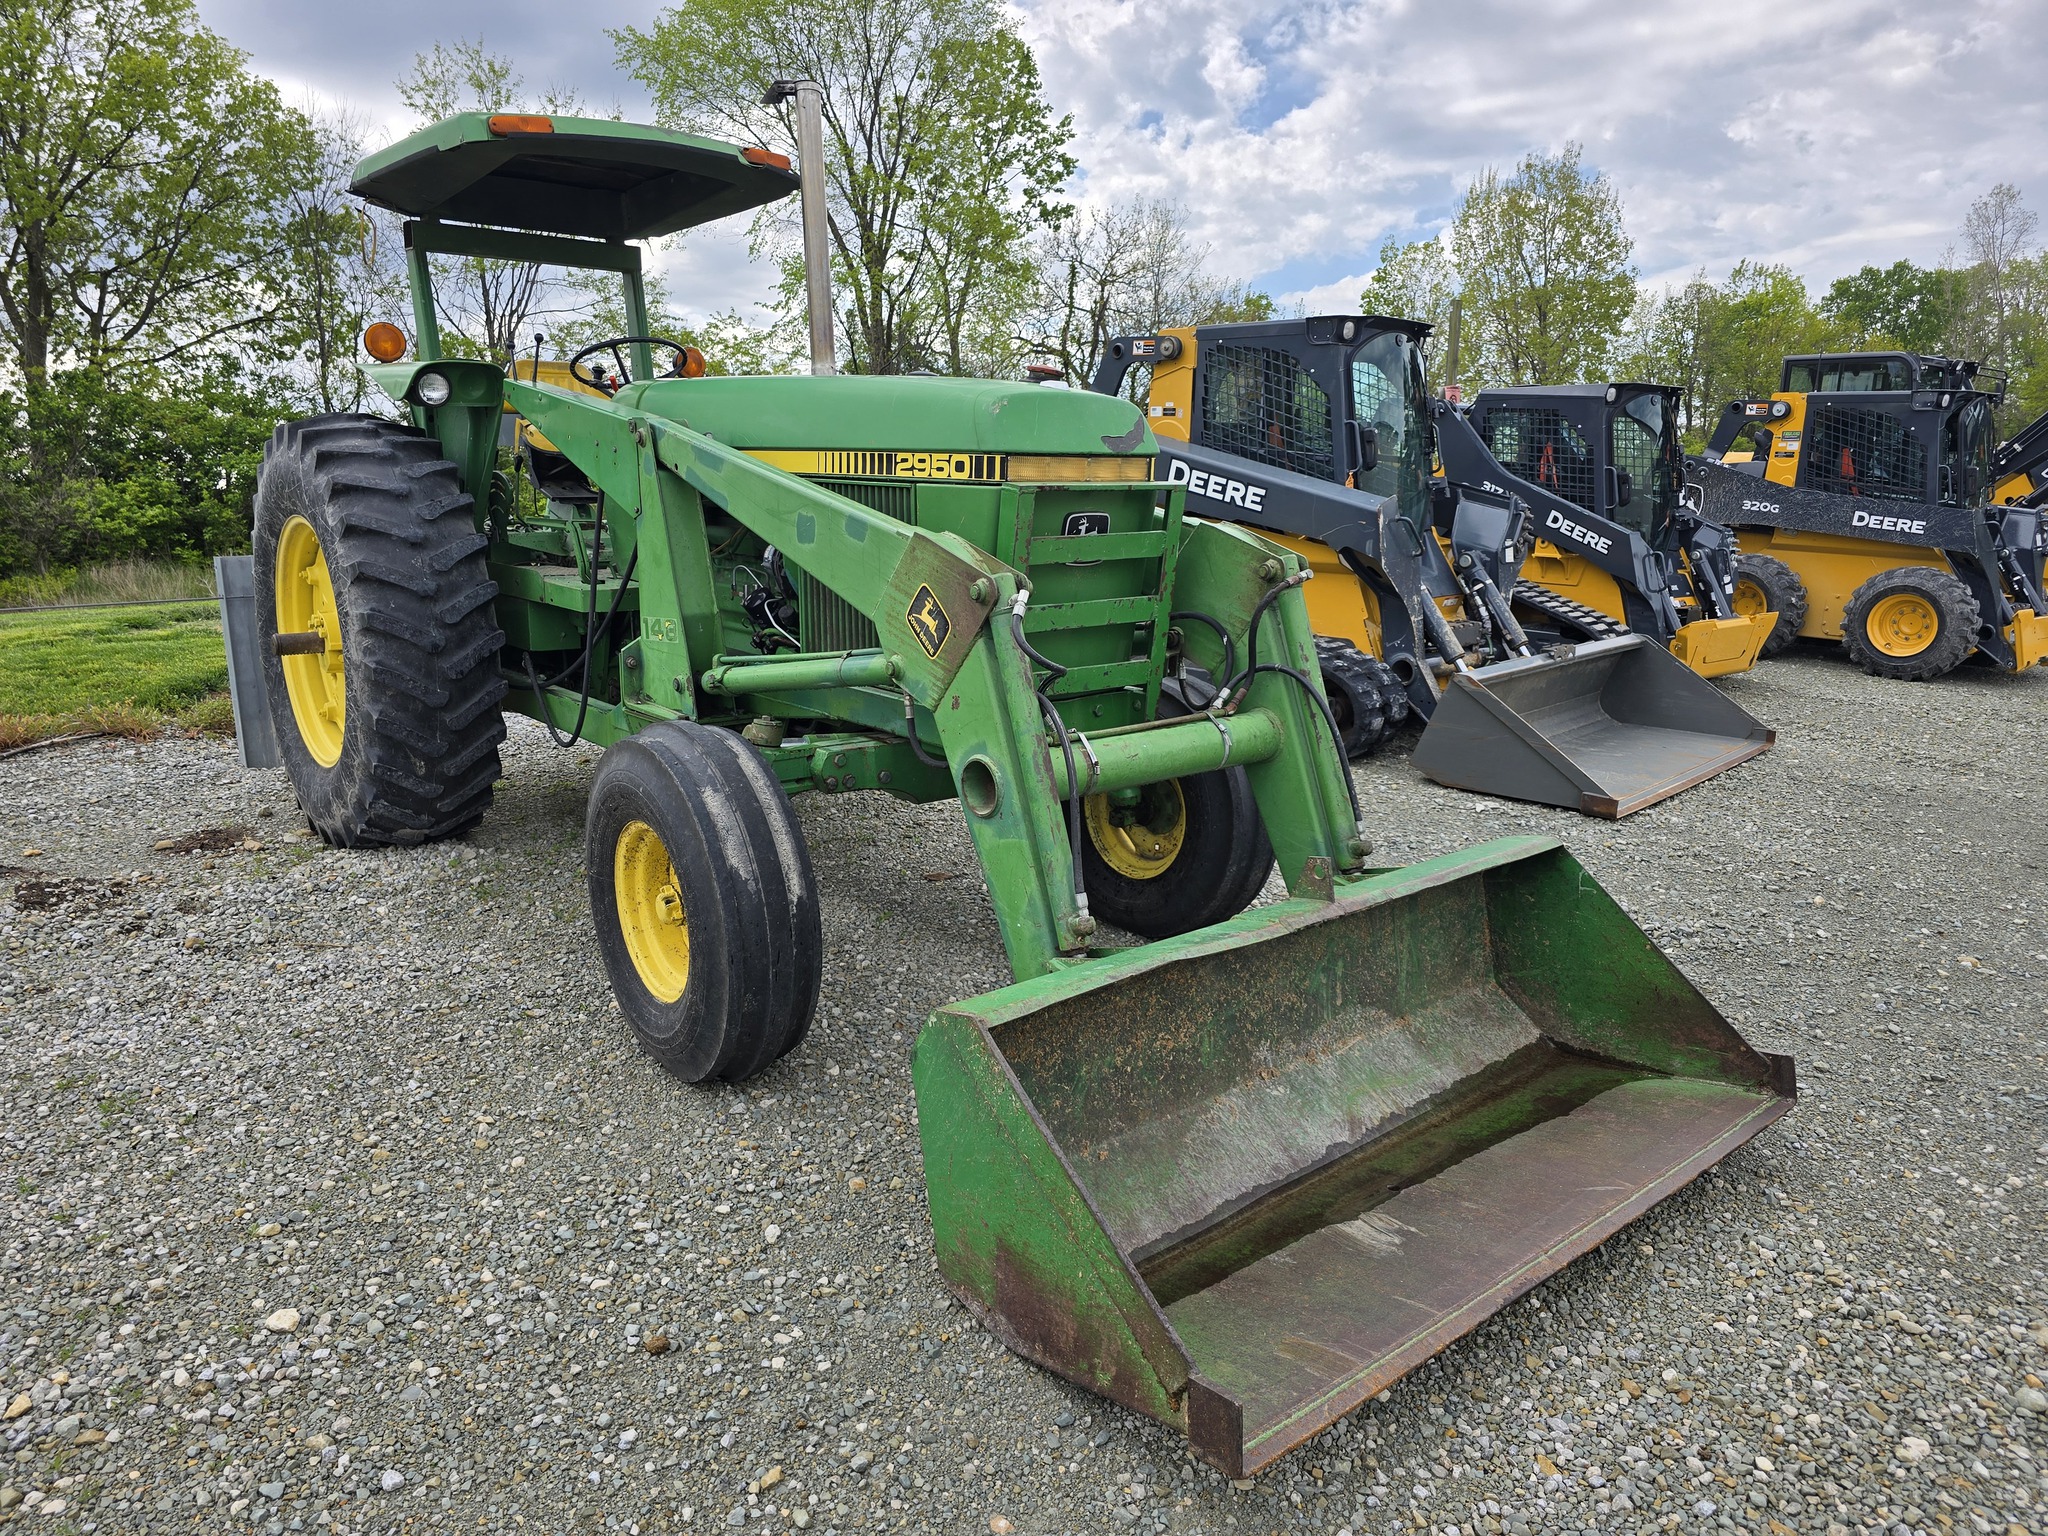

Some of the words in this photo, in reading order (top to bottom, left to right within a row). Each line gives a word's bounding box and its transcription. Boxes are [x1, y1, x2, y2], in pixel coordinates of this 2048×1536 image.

[896, 453, 970, 478] 2950
[1168, 459, 1266, 512] DEERE
[1742, 500, 1780, 513] 320G
[1852, 510, 1927, 535] DEERE
[1545, 509, 1613, 555] DEERE
[908, 615, 921, 633] JOHN
[919, 632, 935, 656] DEERE
